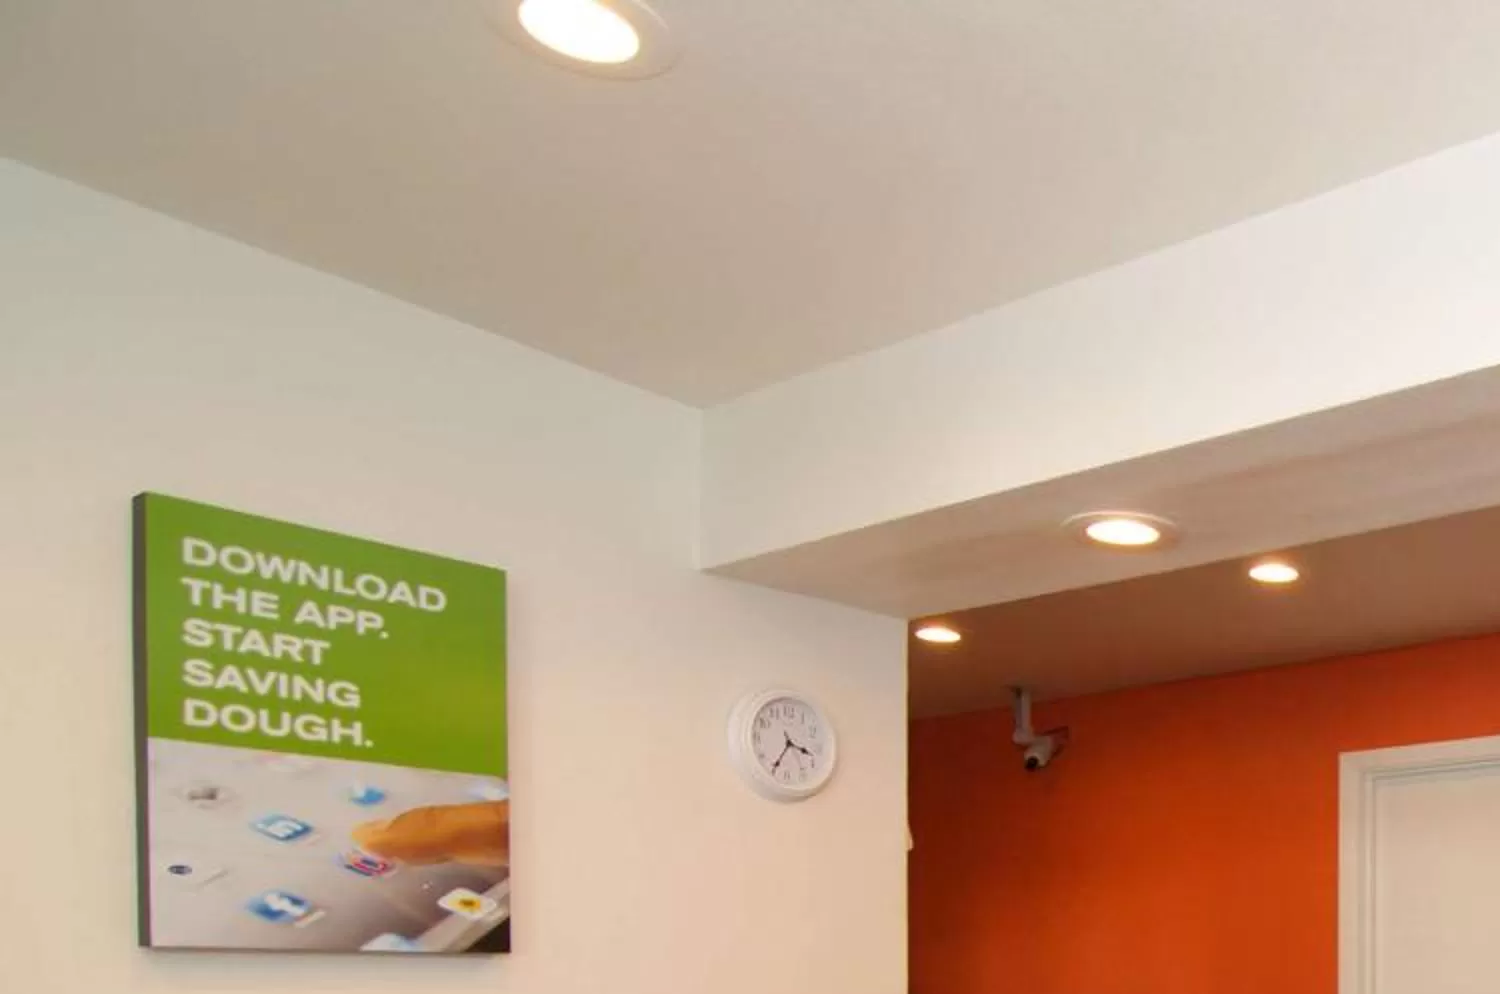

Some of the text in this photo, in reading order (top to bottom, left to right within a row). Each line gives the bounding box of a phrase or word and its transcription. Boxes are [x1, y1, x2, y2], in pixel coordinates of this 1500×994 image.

[181, 535, 448, 612] DOWNLOAD
[180, 576, 390, 640] THE APP.
[182, 617, 331, 666] START
[182, 658, 362, 709] SAVING
[184, 698, 374, 748] DOUGH.
